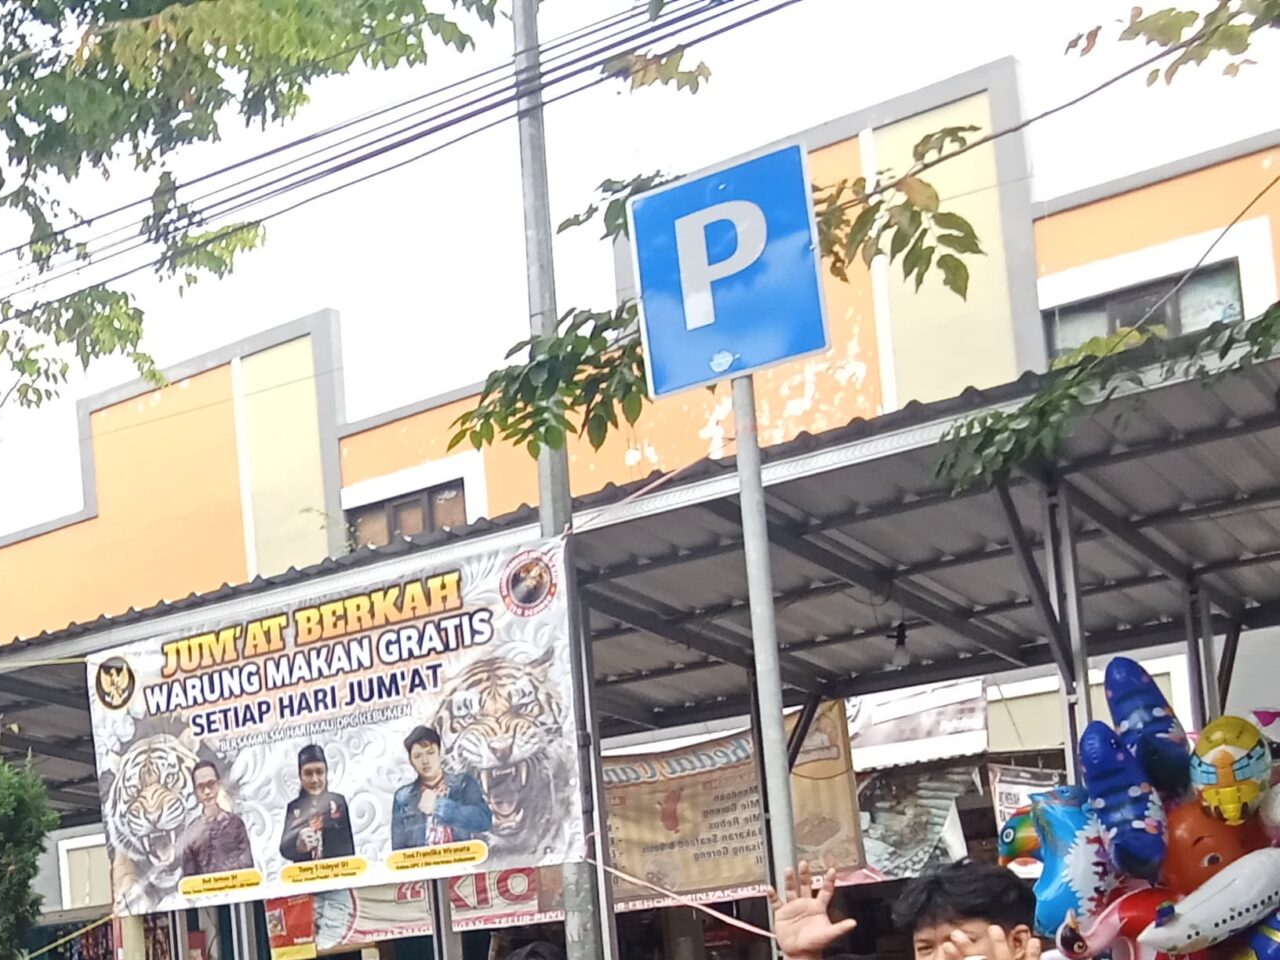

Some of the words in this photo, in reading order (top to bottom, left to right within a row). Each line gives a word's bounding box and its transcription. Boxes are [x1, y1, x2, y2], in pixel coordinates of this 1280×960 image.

[674, 200, 767, 331] P
[144, 662, 260, 715] WARUNG
[265, 637, 372, 691] MAKAN
[377, 609, 494, 664] GRATIS
[162, 613, 288, 677] JUM'AT
[294, 571, 462, 645] BERKAH
[191, 700, 271, 737] SETIAP
[279, 685, 337, 720] HARI
[345, 663, 443, 706] JUM'AT
